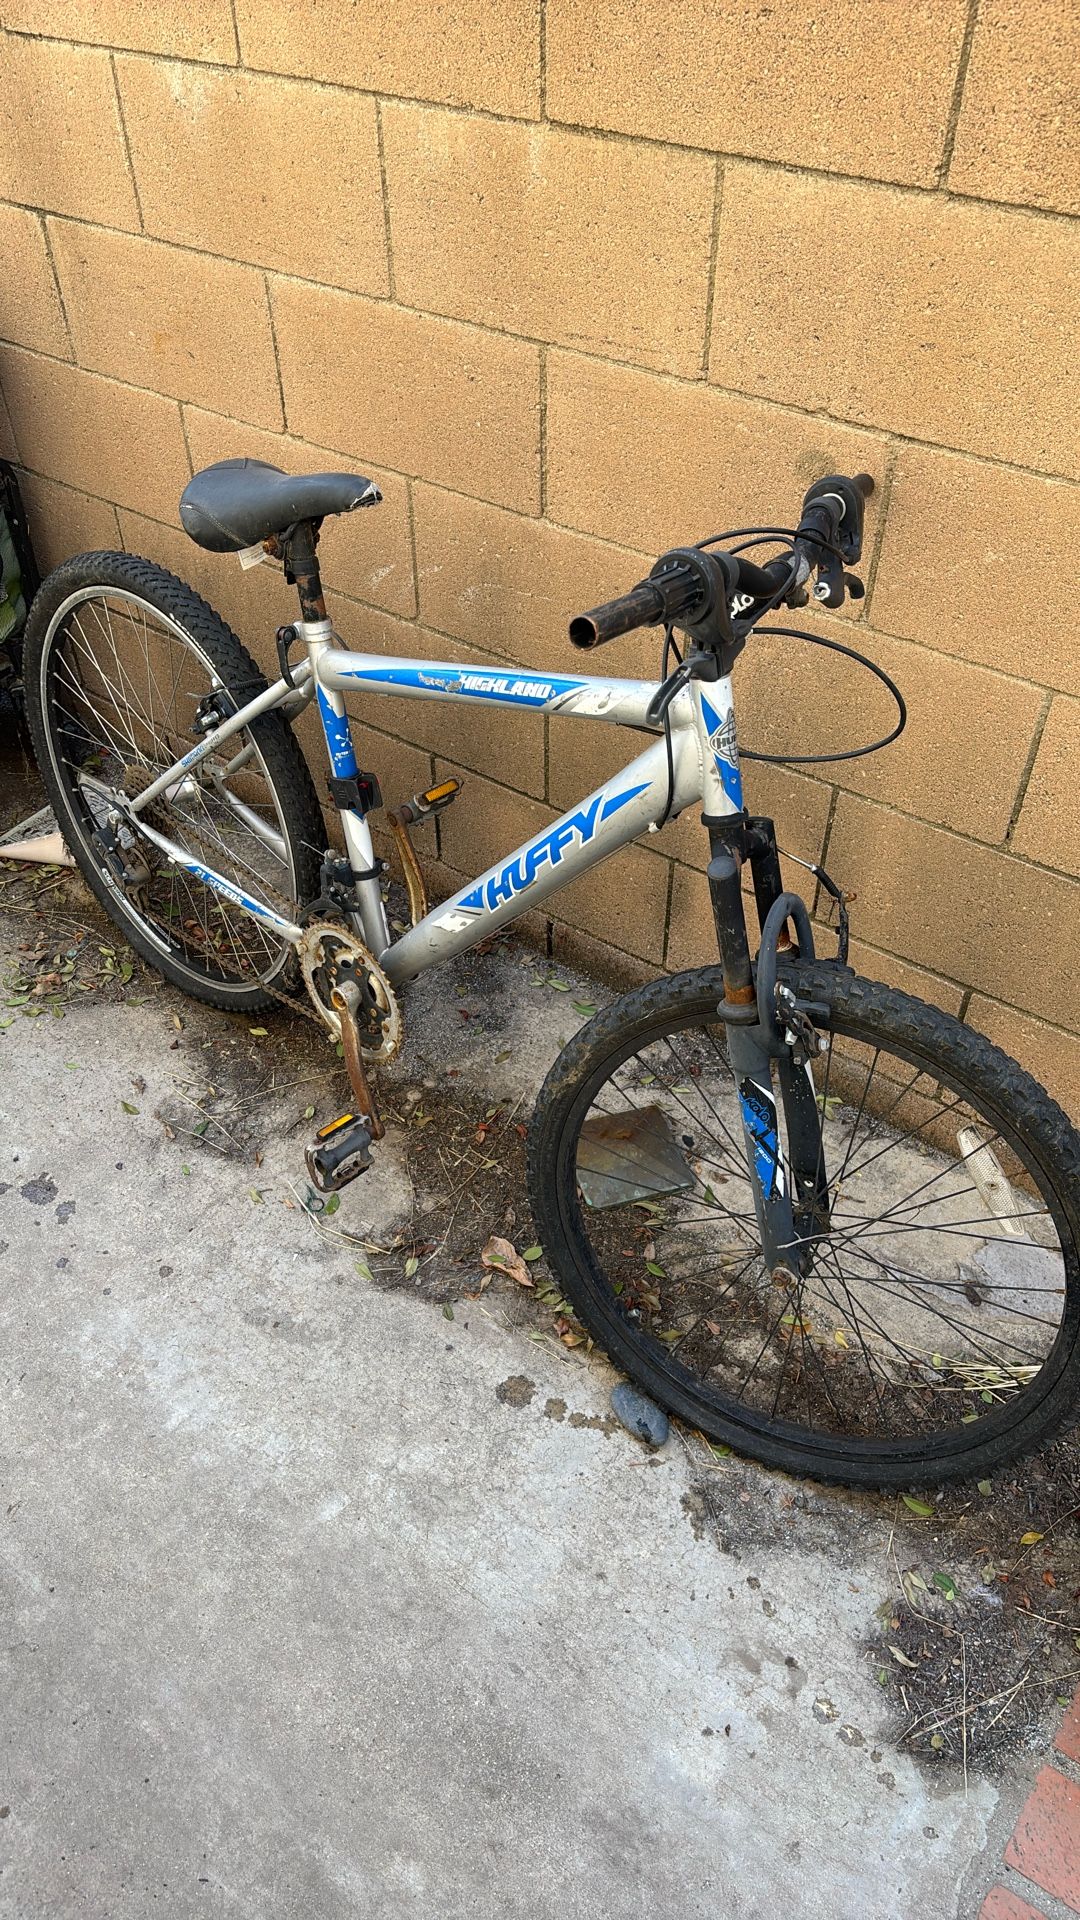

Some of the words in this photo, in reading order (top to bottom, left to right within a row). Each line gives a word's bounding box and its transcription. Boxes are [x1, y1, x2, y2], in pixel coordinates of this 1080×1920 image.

[460, 673, 552, 699] HIGHLAND
[485, 790, 606, 913] HUFFY
[194, 867, 206, 879] 21
[208, 878, 245, 903] SPEEDS
